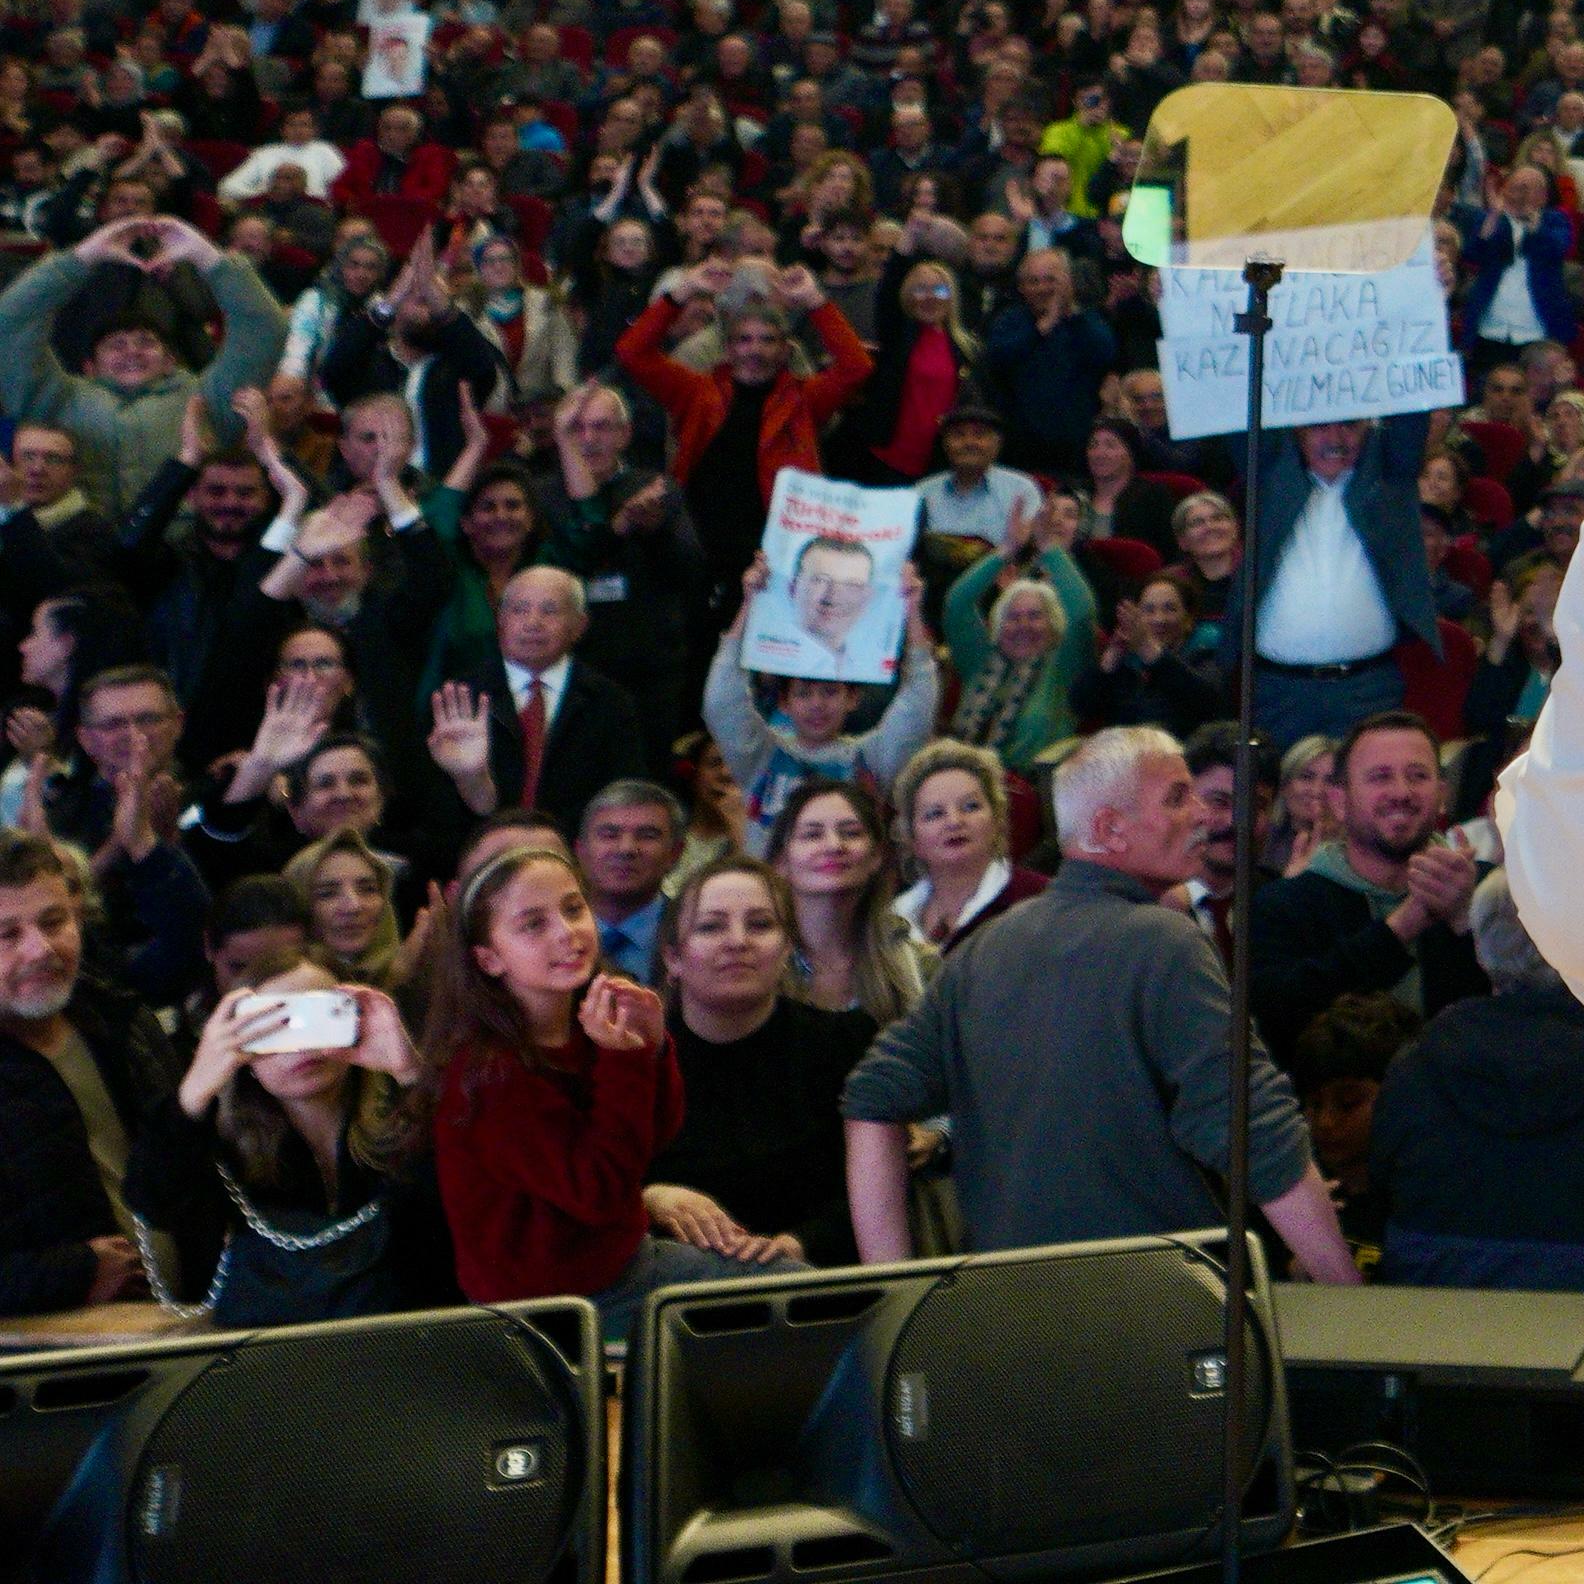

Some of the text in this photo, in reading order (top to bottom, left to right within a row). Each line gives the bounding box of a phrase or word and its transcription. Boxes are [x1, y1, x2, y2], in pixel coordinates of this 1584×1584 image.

[1209, 279, 1380, 338] MTLAKA
[1174, 319, 1434, 381] KAZNACAĞIZ
[1264, 365, 1391, 413] YILMAZ
